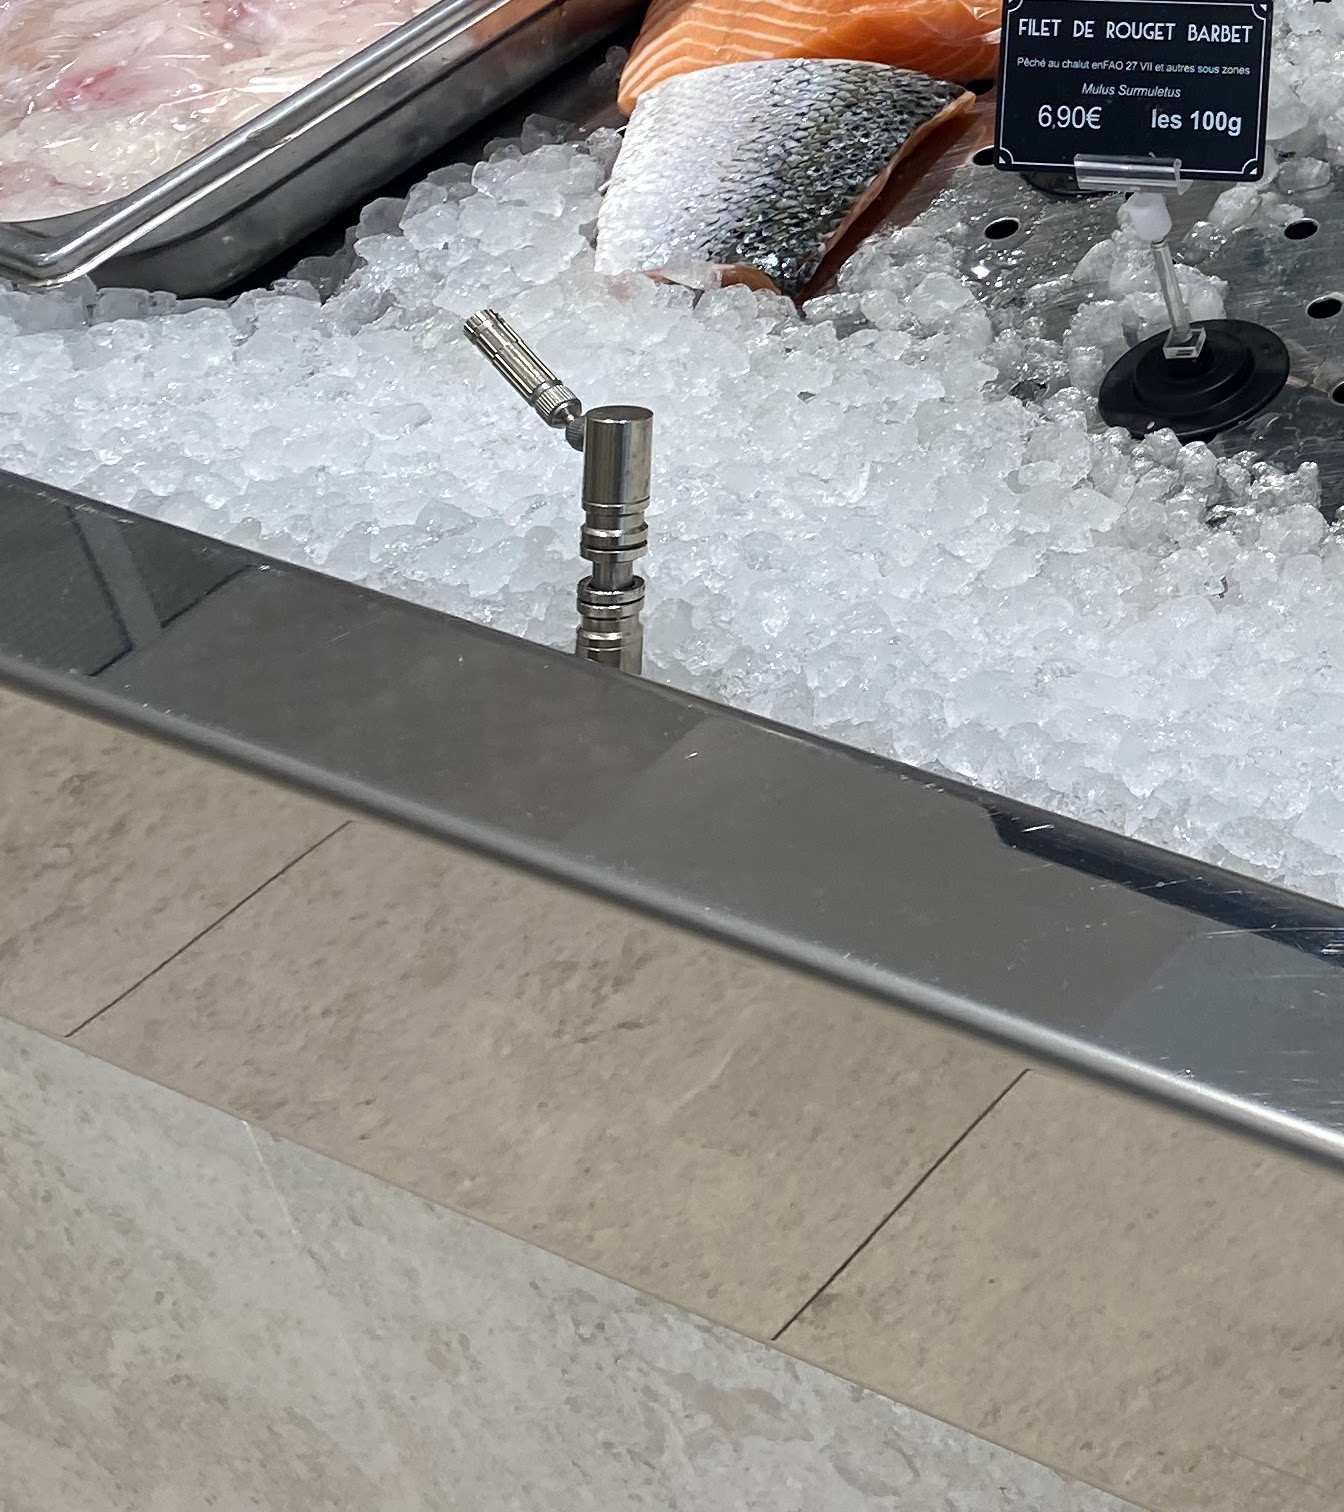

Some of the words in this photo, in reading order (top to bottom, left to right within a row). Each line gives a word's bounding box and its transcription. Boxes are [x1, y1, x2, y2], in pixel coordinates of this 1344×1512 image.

[1018, 18, 1062, 37] FILET
[1073, 20, 1095, 38] DE
[1106, 21, 1176, 41] ROUGET
[1187, 24, 1254, 43] BARBET
[1017, 56, 1046, 68] Pêché
[1048, 60, 1060, 68] au
[1062, 59, 1090, 69] chalut
[1126, 62, 1138, 71] 27
[1140, 62, 1153, 72] VII
[1155, 63, 1165, 72] et
[1166, 64, 1195, 73] autres
[1197, 66, 1220, 74] sous
[1222, 66, 1250, 75] zones
[1081, 83, 1115, 95] Mulus
[1117, 84, 1182, 98] Surmuletus
[1038, 104, 1102, 130] 6,90€
[1151, 108, 1182, 129] les
[1190, 110, 1242, 136] 100g
